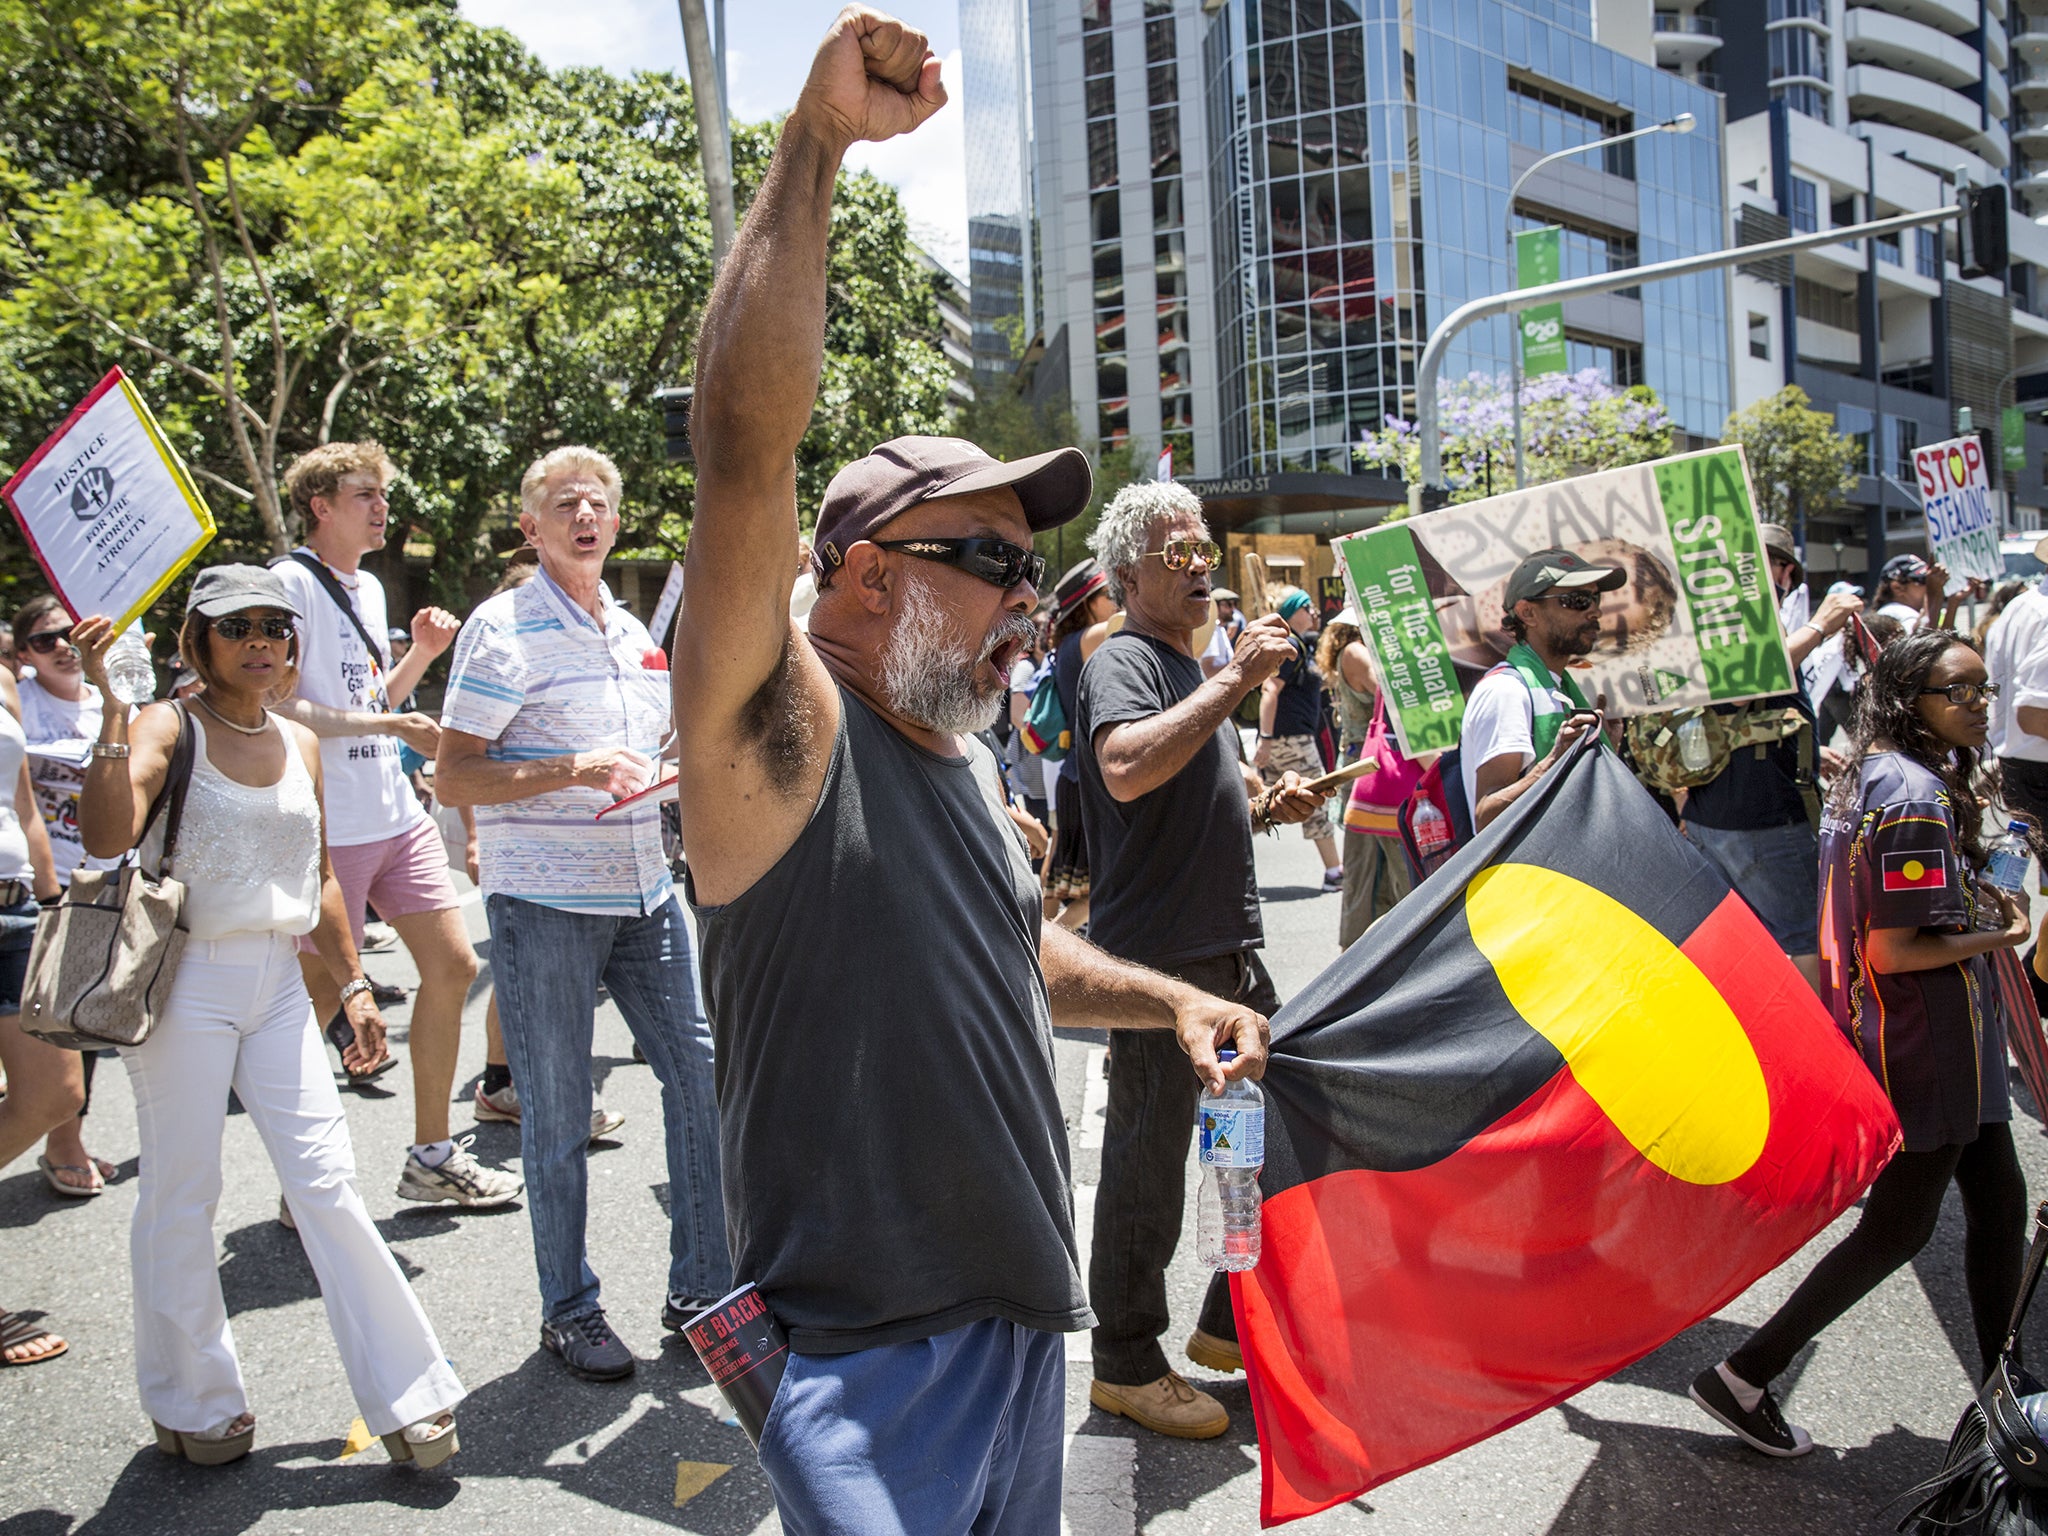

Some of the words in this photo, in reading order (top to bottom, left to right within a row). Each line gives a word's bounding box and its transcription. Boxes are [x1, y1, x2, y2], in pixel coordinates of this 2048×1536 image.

[53, 432, 109, 495] JUSTICE
[1254, 476, 1271, 492] ST
[1916, 441, 1980, 497] STOP
[85, 514, 109, 544] FOR
[107, 494, 131, 520] THE
[94, 510, 135, 553] MOREE
[1926, 485, 1993, 542] STEALING
[96, 514, 148, 574] ATROCITY
[1387, 564, 1417, 595] for
[1673, 514, 1749, 651] STONE
[1733, 551, 1762, 602] Adam
[1399, 597, 1431, 639] The
[1360, 584, 1421, 709] qld.greens.org.au
[1413, 641, 1455, 713] Senate
[709, 1291, 767, 1340] BLACKS
[721, 1352, 753, 1377] RESISTANCE
